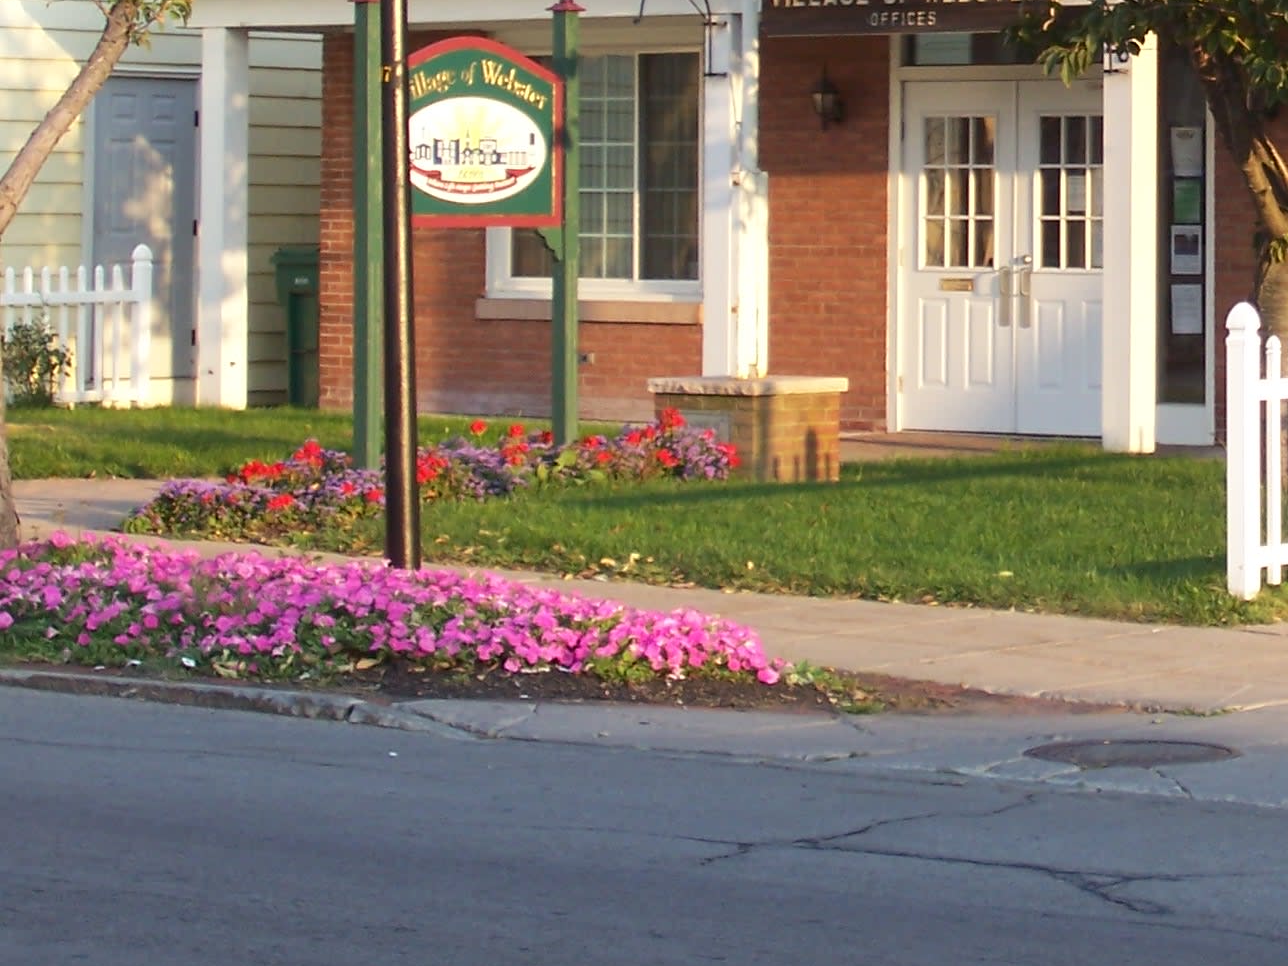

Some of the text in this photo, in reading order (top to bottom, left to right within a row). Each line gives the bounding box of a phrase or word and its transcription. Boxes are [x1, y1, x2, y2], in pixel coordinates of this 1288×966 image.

[870, 11, 937, 26] OFFICES
[408, 59, 549, 110] illage of Webster
